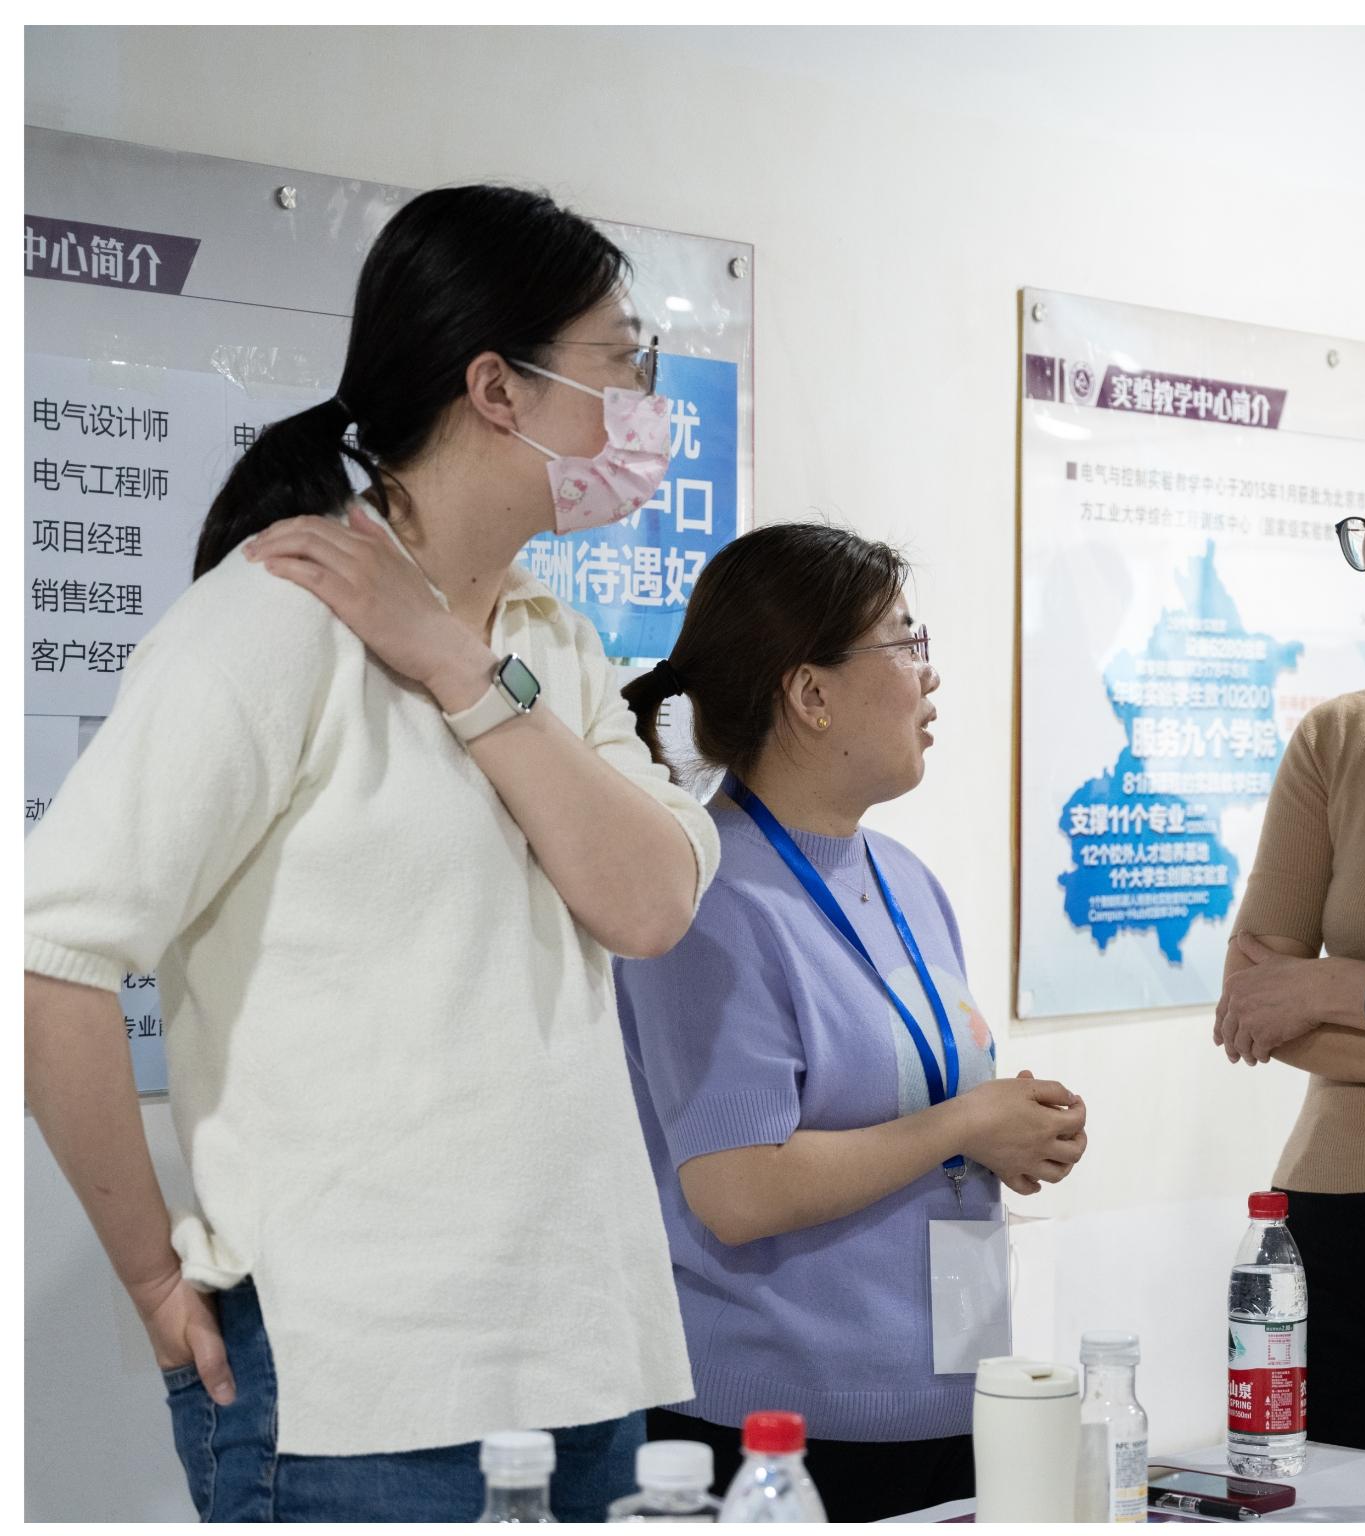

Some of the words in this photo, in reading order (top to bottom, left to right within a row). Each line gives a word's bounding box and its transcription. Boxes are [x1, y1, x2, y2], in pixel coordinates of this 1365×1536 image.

[24, 228, 162, 286] 中心简介
[32, 398, 170, 443] 电气设计师
[1111, 372, 1271, 427] 实验教学中心简介
[32, 456, 170, 500] 电气工程师
[32, 520, 143, 560] 项目经理
[516, 540, 706, 607] 酬待遇好
[31, 578, 144, 617] 销售经理
[1131, 716, 1279, 760] 服务九个学院
[25, 797, 53, 822] 动
[124, 1014, 162, 1039] 专业
